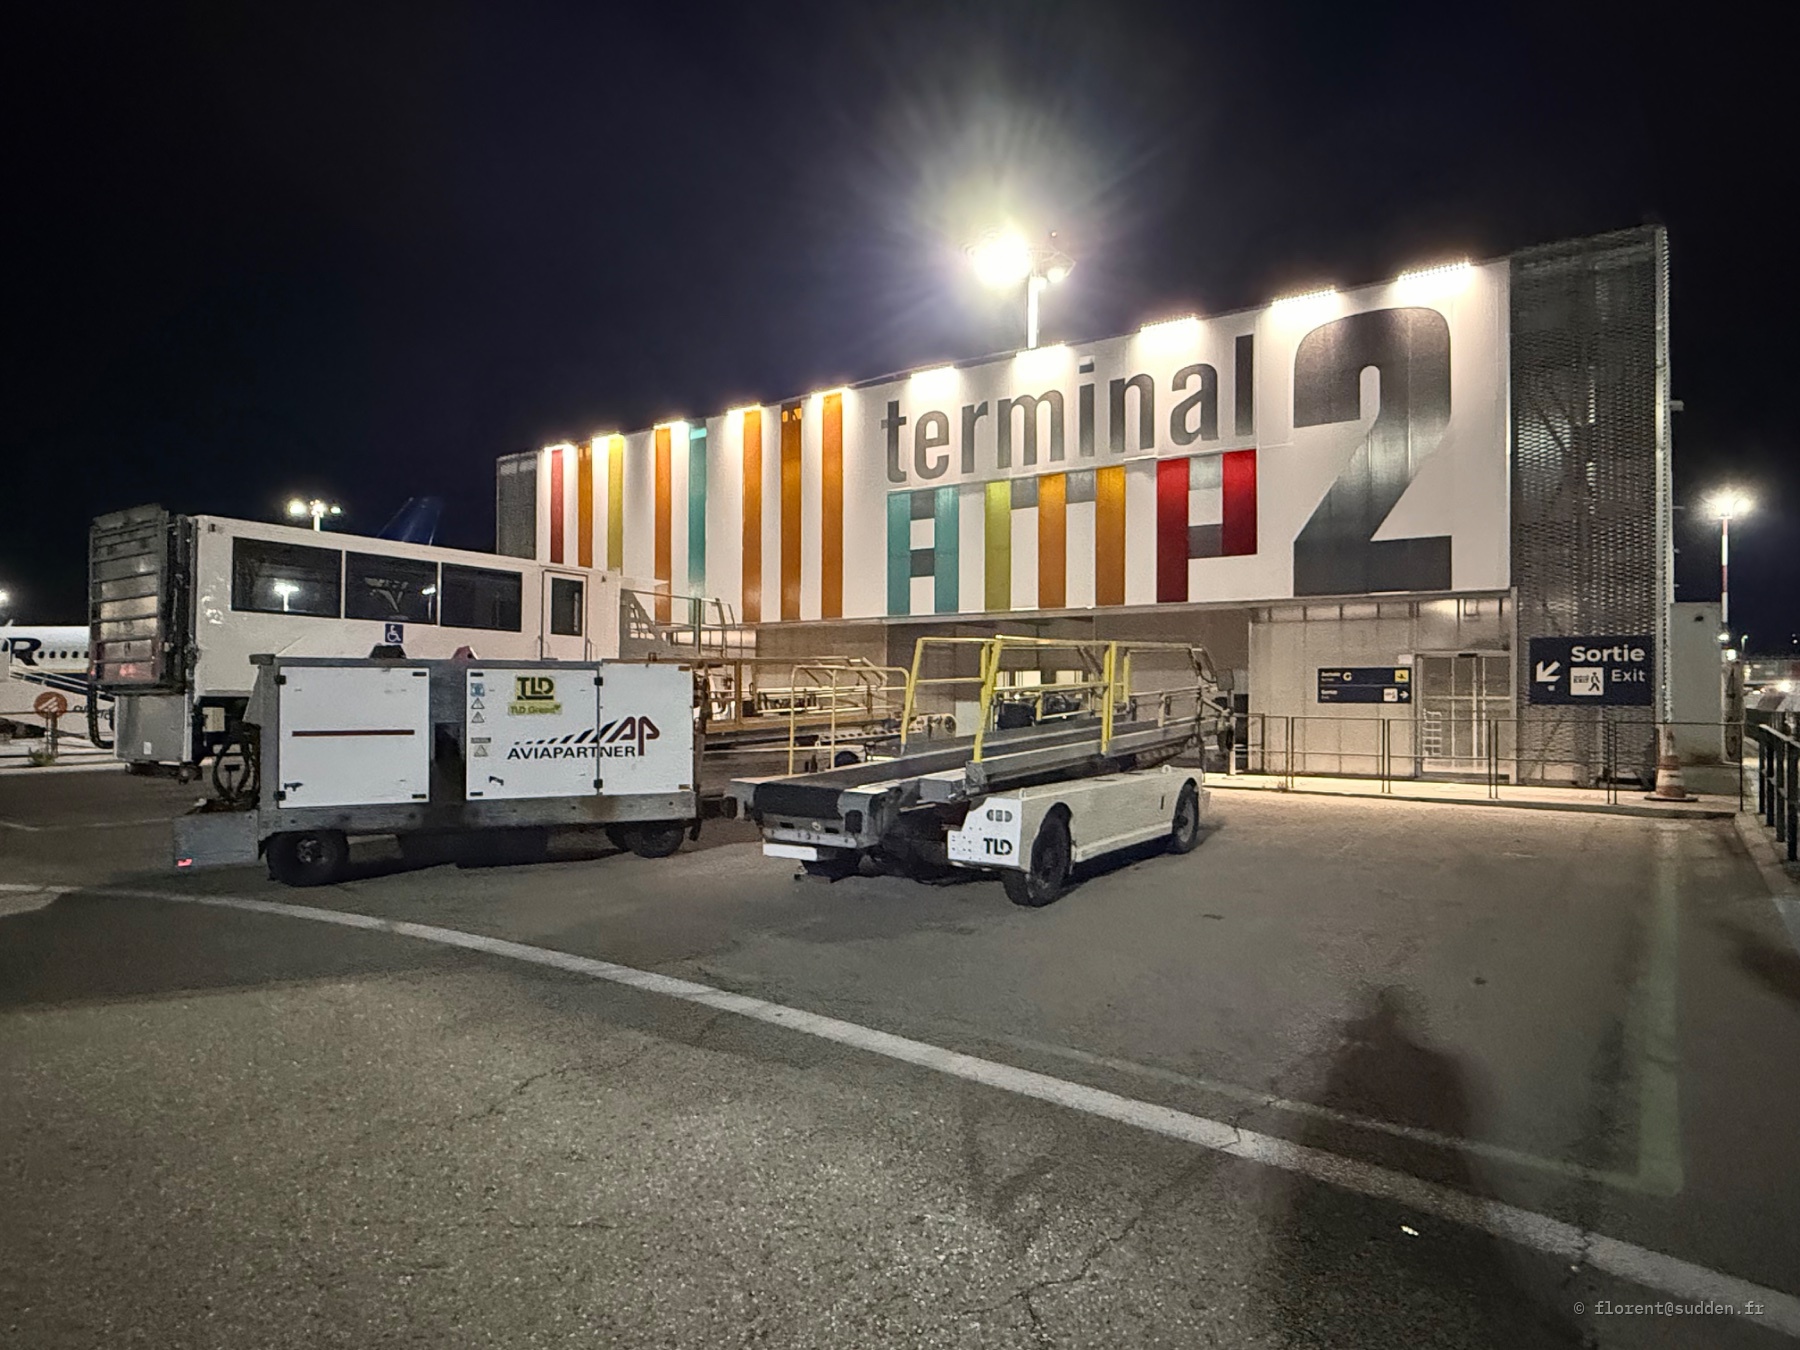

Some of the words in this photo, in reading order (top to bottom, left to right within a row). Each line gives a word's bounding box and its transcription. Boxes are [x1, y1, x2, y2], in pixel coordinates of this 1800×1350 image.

[881, 333, 1254, 484] terminal
[1294, 306, 1452, 597] 2
[1571, 644, 1646, 662] Sortie
[1611, 669, 1646, 682] Exit
[517, 677, 554, 696] TLD
[511, 705, 526, 714] TLD
[507, 745, 636, 761] AVIAPARTNER
[983, 837, 1013, 856] TLD
